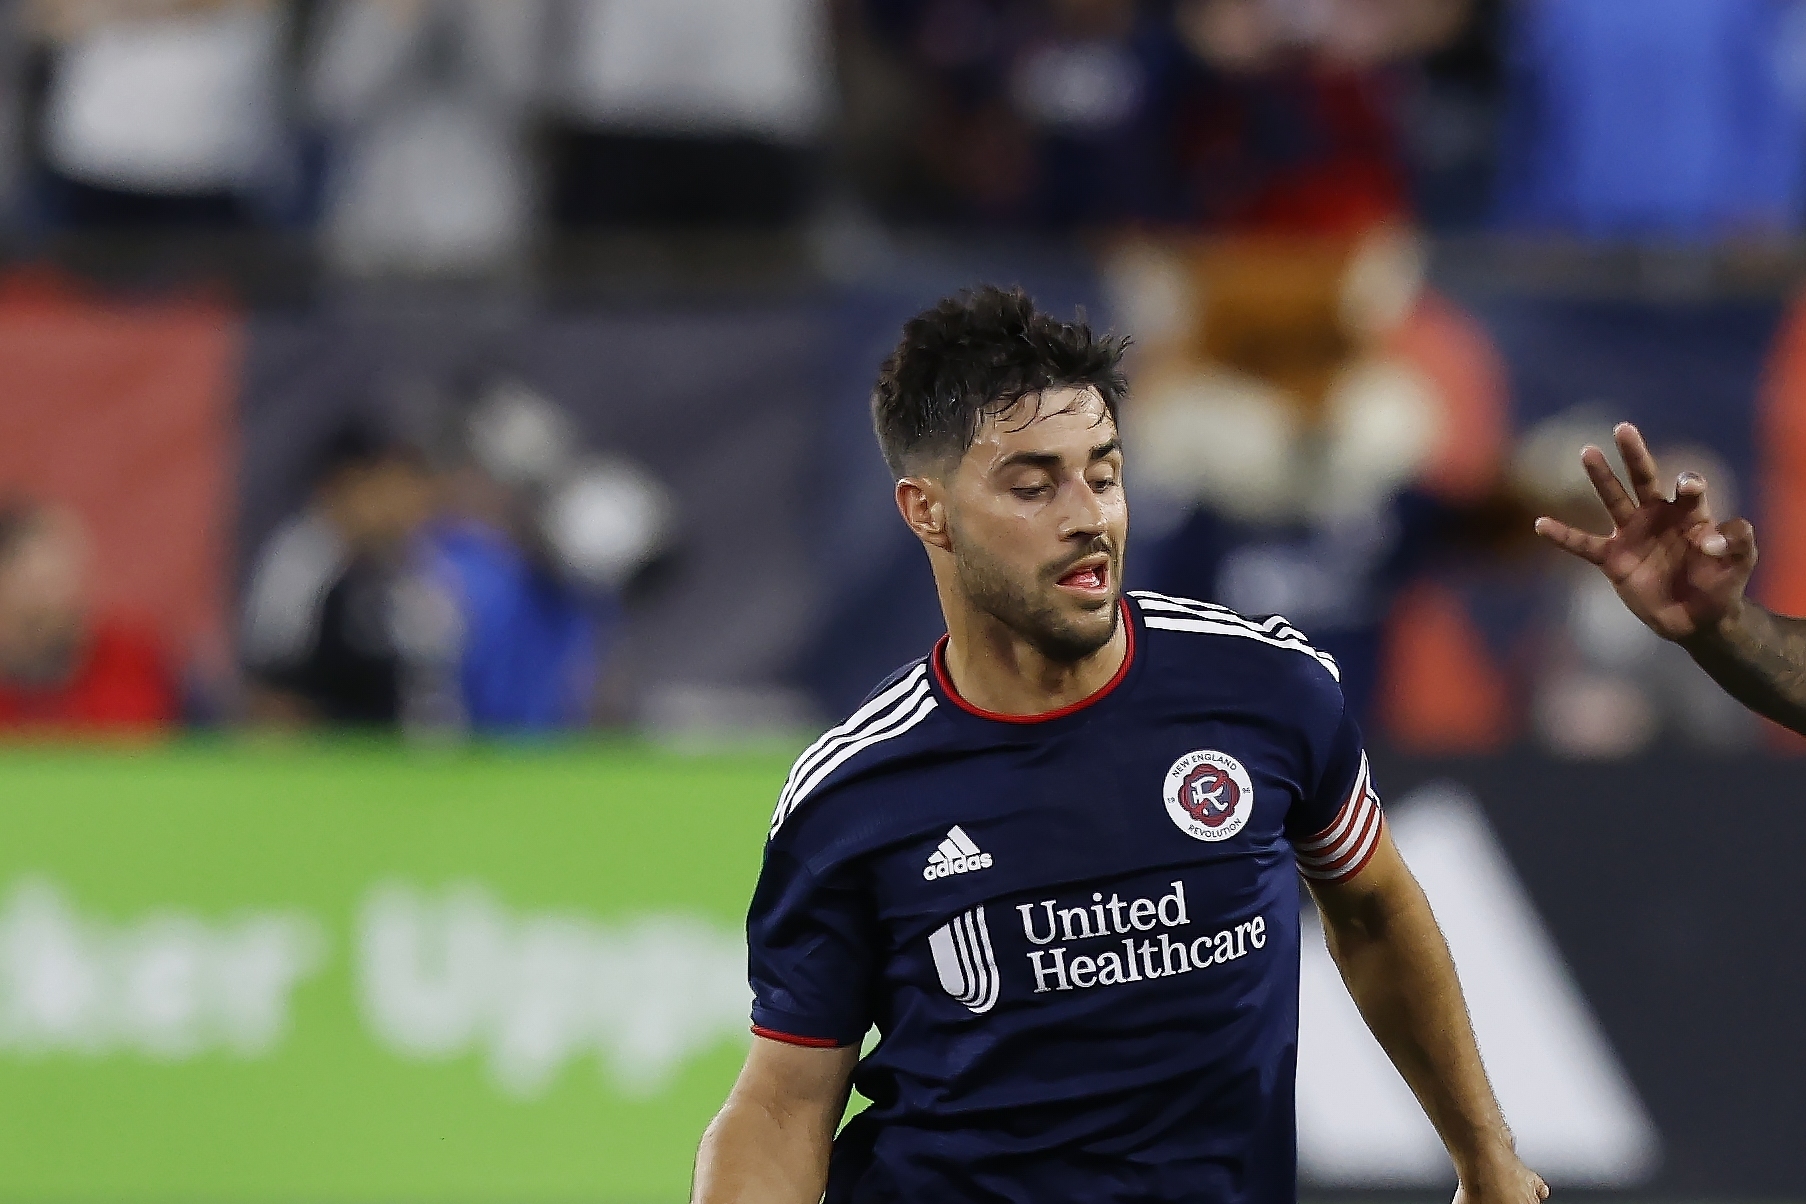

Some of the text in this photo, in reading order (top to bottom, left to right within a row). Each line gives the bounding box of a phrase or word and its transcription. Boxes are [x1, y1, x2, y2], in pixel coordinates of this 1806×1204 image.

[1171, 753, 1238, 778] NEW ENGLAND
[1188, 817, 1243, 838] REVOLUTION
[923, 852, 994, 881] adidas
[1016, 880, 1191, 945] United
[1026, 916, 1267, 993] Healthcare
